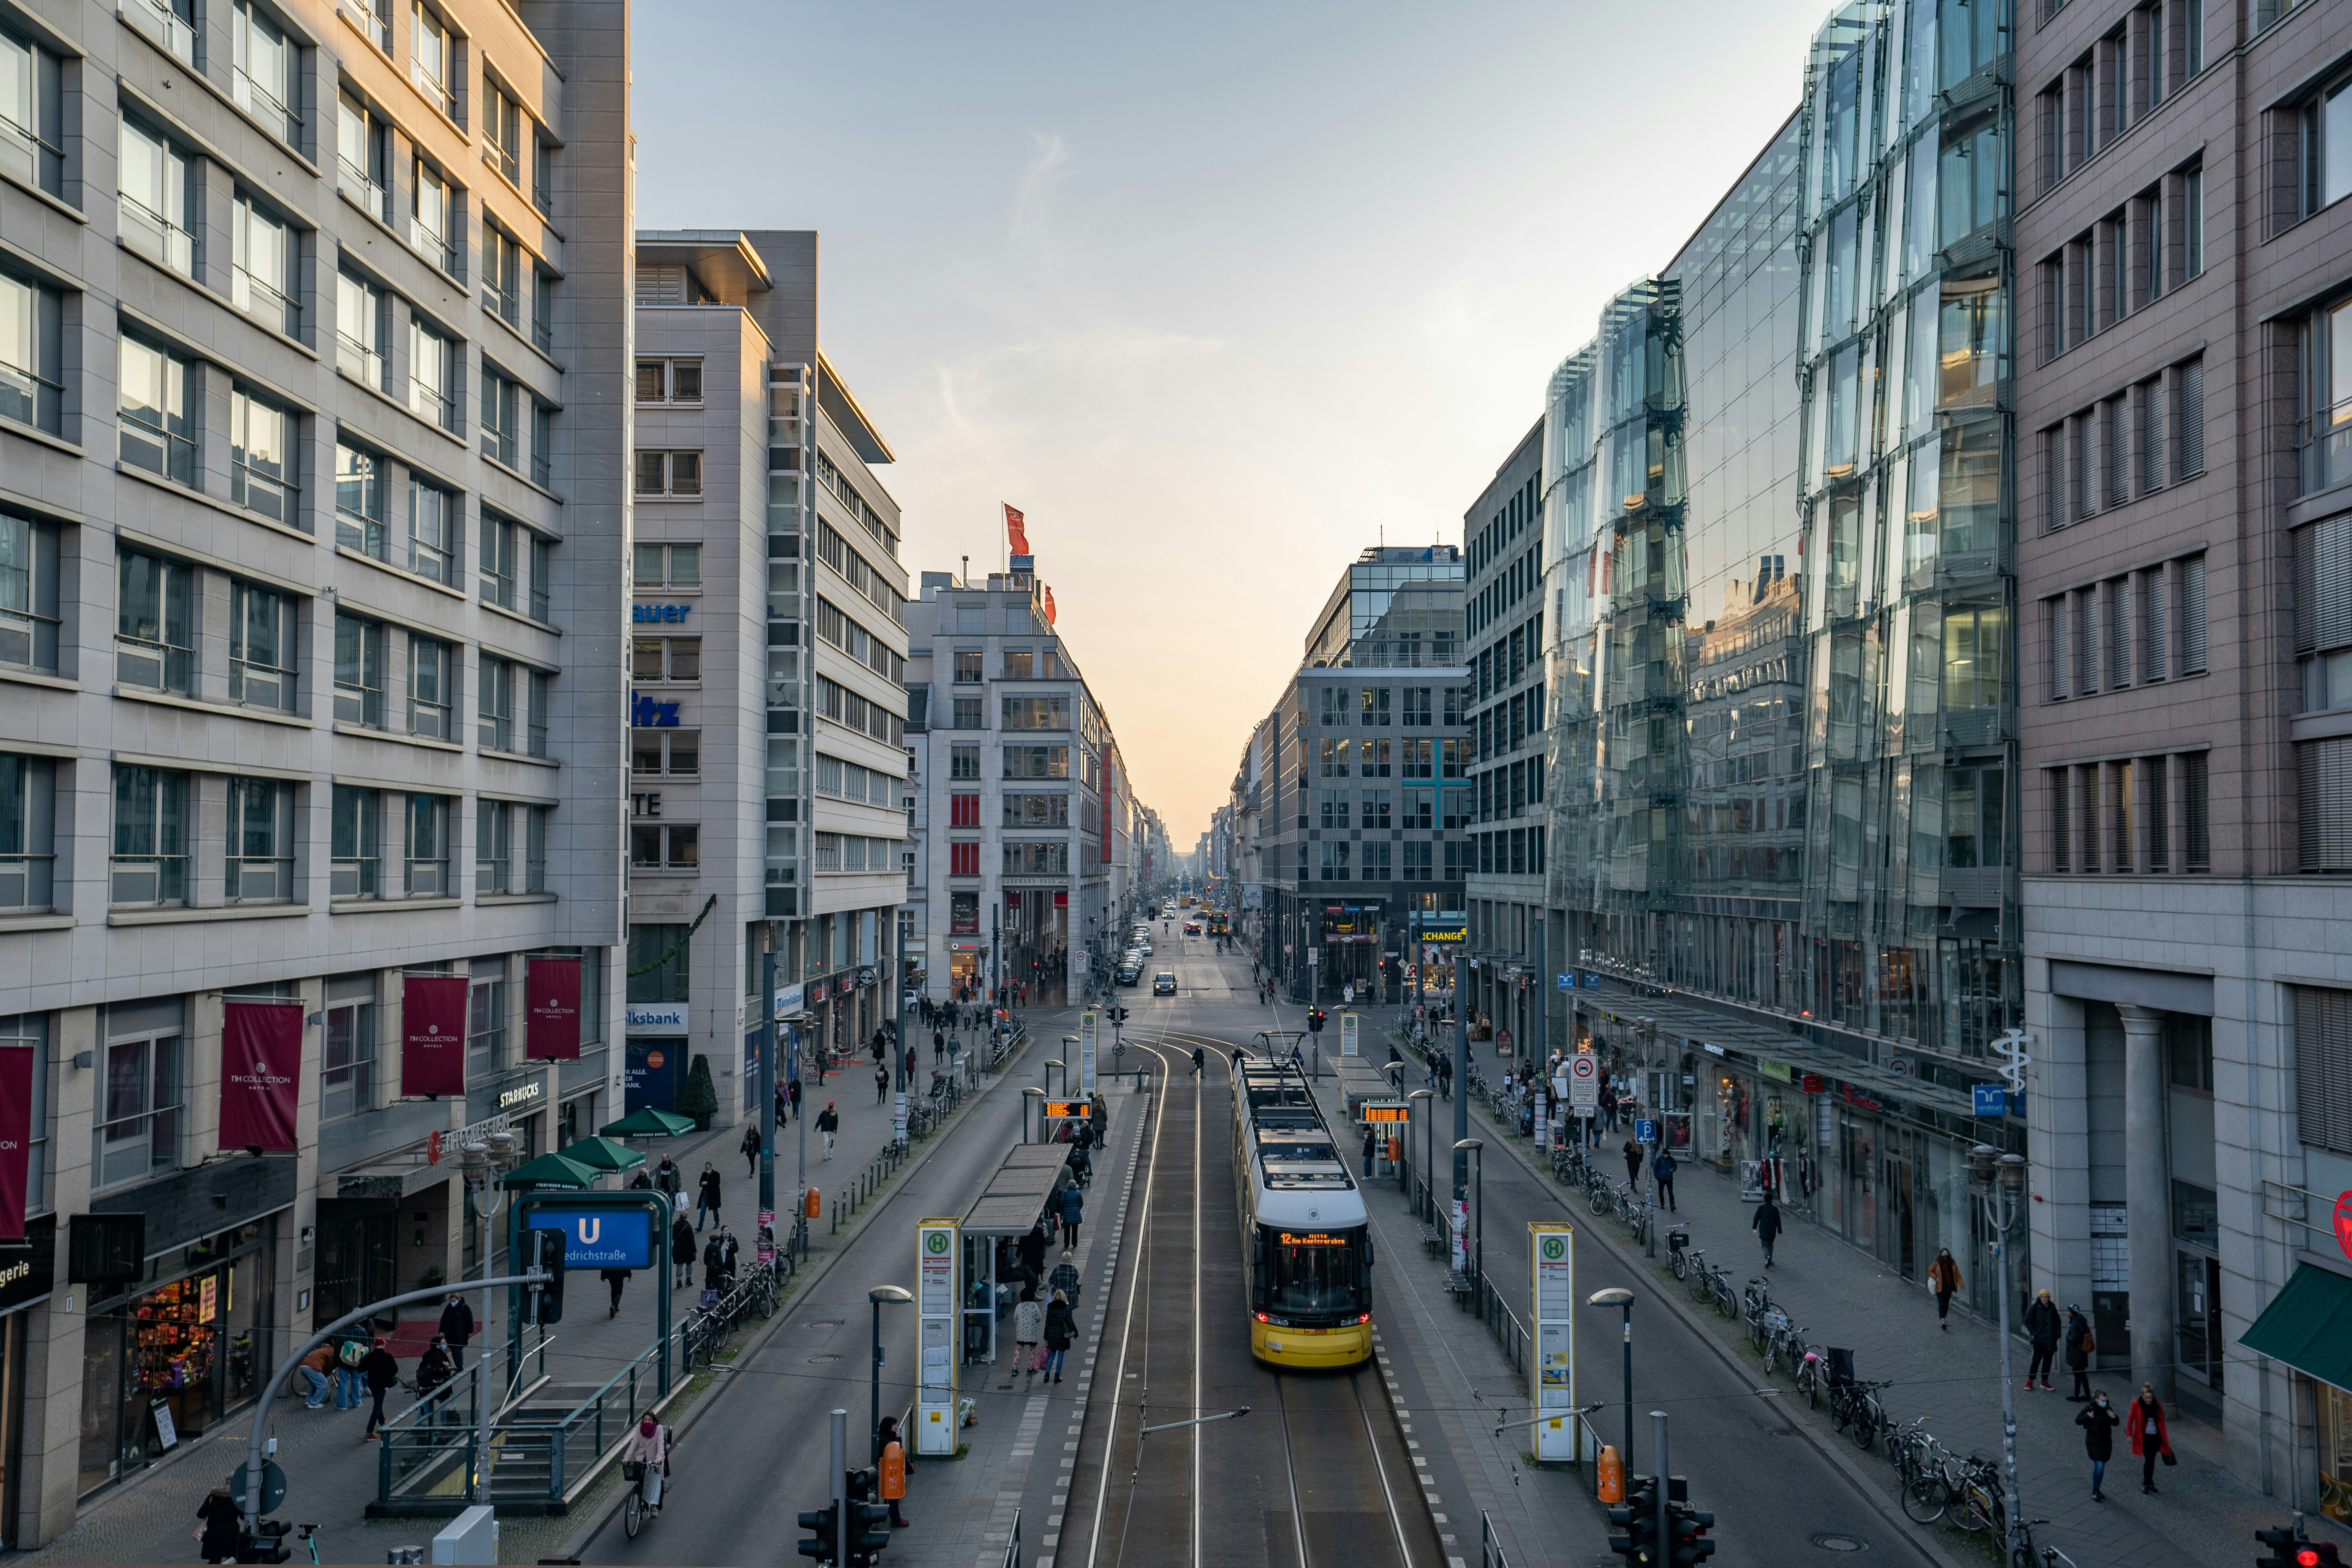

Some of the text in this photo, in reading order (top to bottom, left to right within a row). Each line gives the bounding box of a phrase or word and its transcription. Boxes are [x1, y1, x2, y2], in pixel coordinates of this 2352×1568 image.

[633, 605, 691, 621] auer
[626, 1012, 680, 1024] lksbank
[500, 1082, 539, 1108] STARBUCKS
[460, 1112, 509, 1147] COLLECTION
[1644, 1125, 1651, 1137] P
[579, 1218, 600, 1244] U
[933, 1237, 943, 1249] H
[1280, 1233, 1291, 1244] 12
[1549, 1243, 1559, 1254] H
